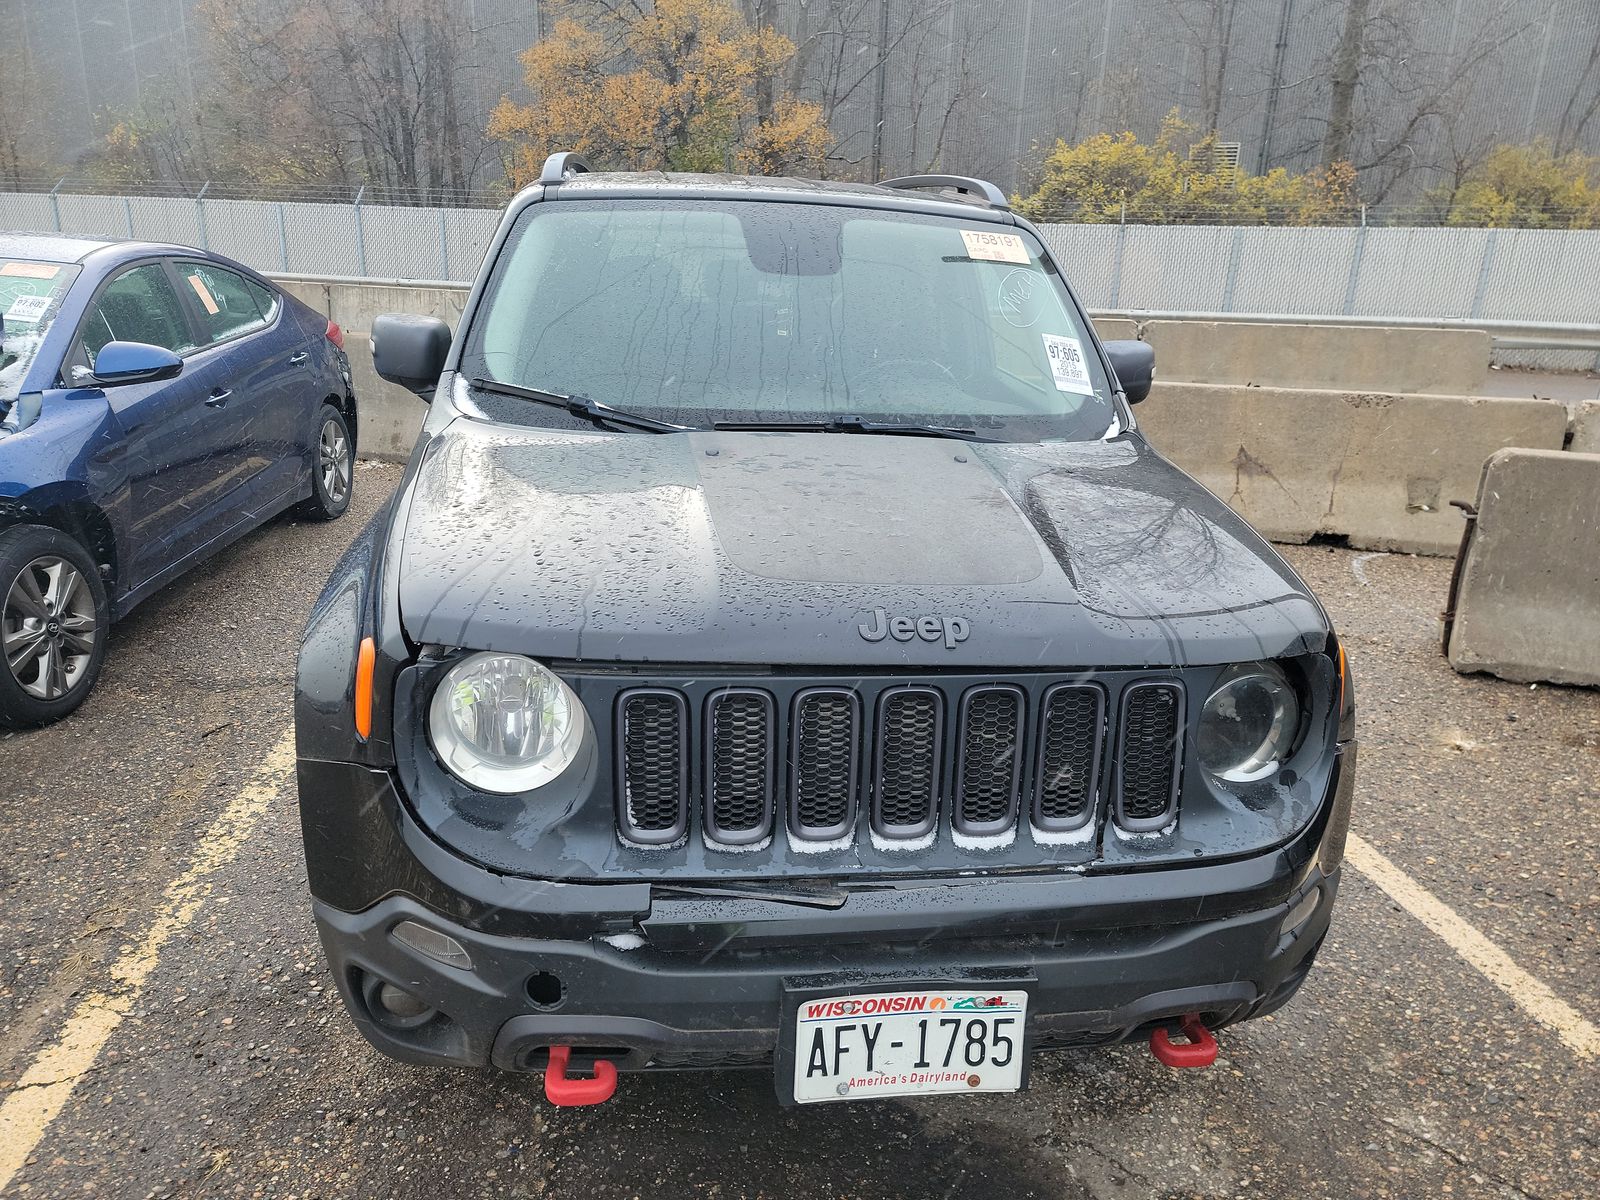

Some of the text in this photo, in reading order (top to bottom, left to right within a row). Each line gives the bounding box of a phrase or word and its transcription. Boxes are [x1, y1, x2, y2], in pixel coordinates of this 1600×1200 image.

[966, 233, 1019, 248] 1758191
[1048, 344, 1080, 363] 97:605
[1059, 359, 1077, 370] 2015
[857, 609, 970, 649] Jeep
[807, 996, 927, 1018] WISCONSIN
[806, 1018, 1016, 1078] AFY-1785
[848, 1071, 967, 1089] America's Dairyland
